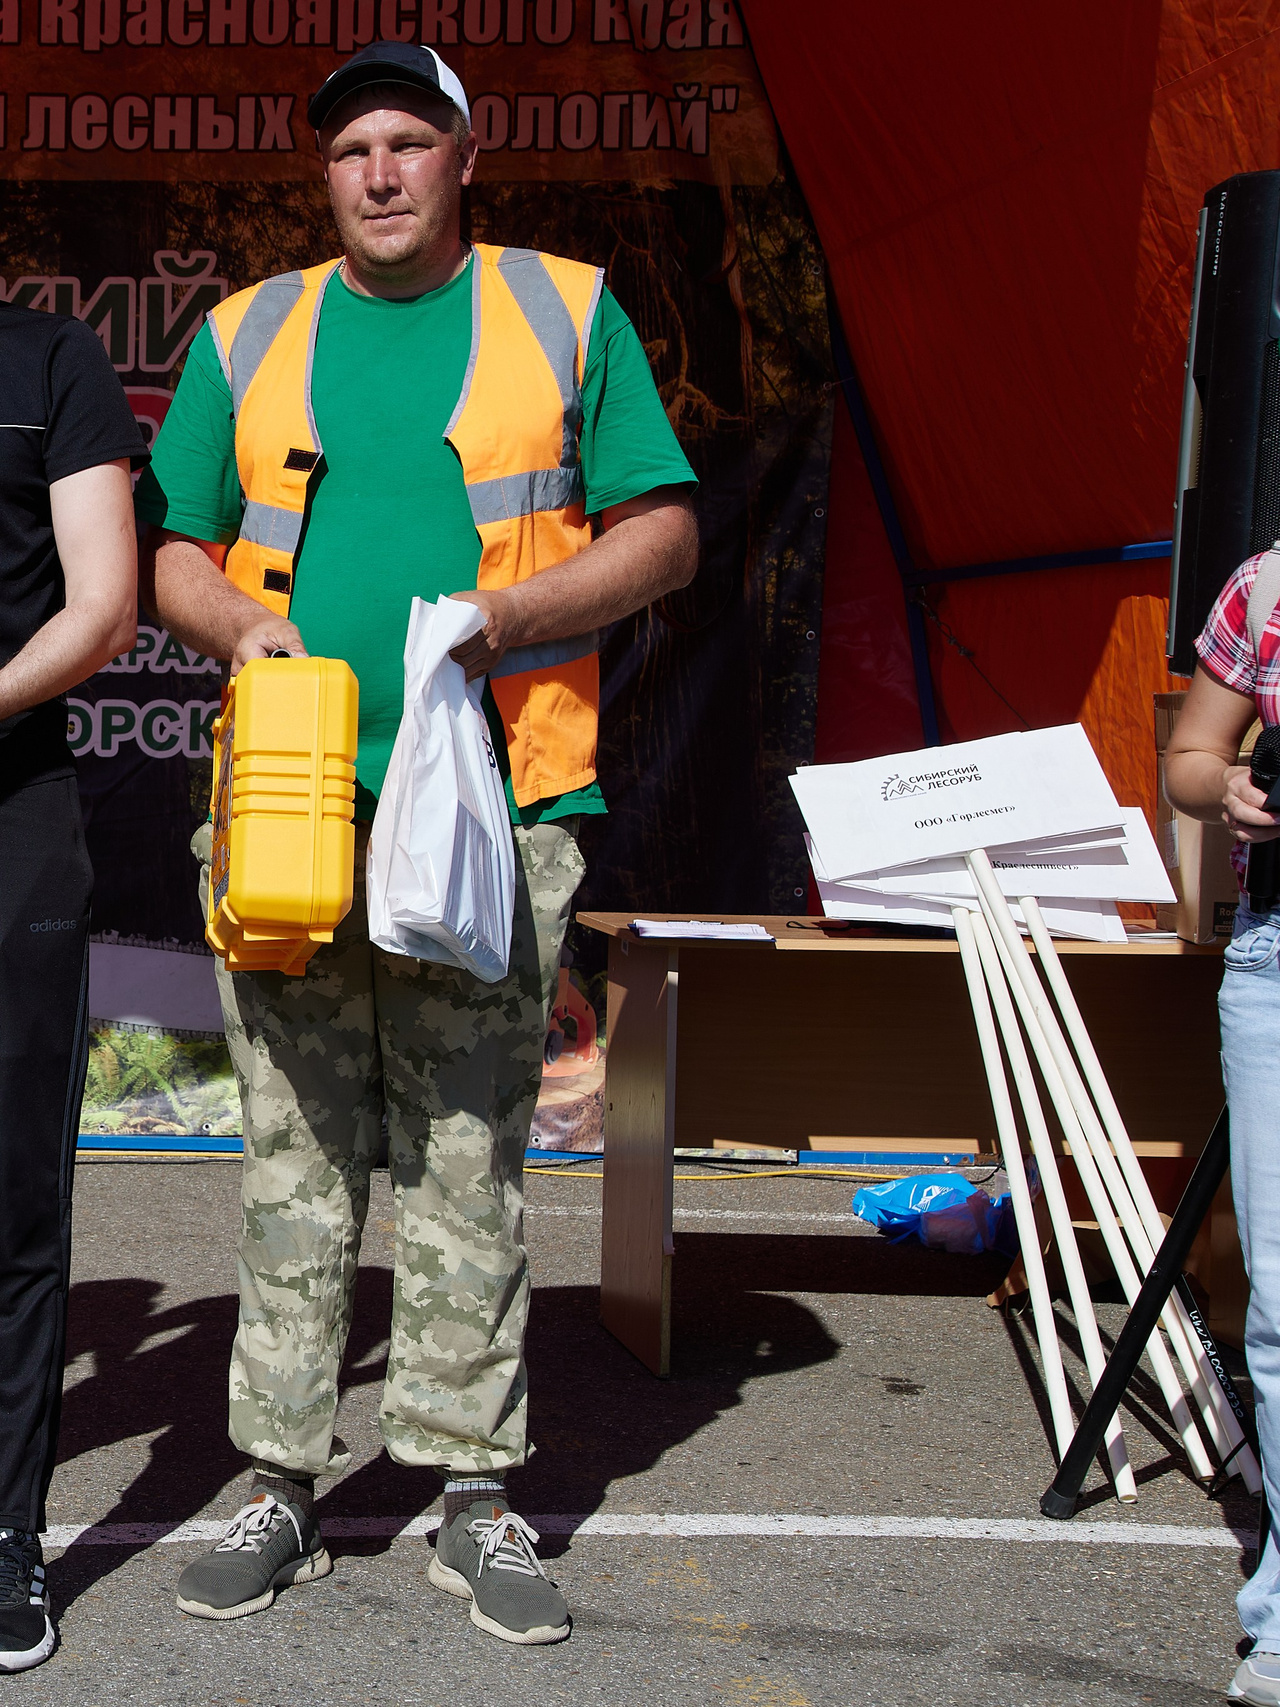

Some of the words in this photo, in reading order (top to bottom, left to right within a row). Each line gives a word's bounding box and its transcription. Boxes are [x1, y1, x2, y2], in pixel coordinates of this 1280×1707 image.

[22, 90, 297, 152] лесных
[310, 82, 740, 156] ологий"
[908, 763, 980, 784] СИБИРСКИЙ
[927, 773, 982, 790] ЛЕСОРУБ
[914, 816, 943, 830] ООО
[29, 917, 78, 933] adidas
